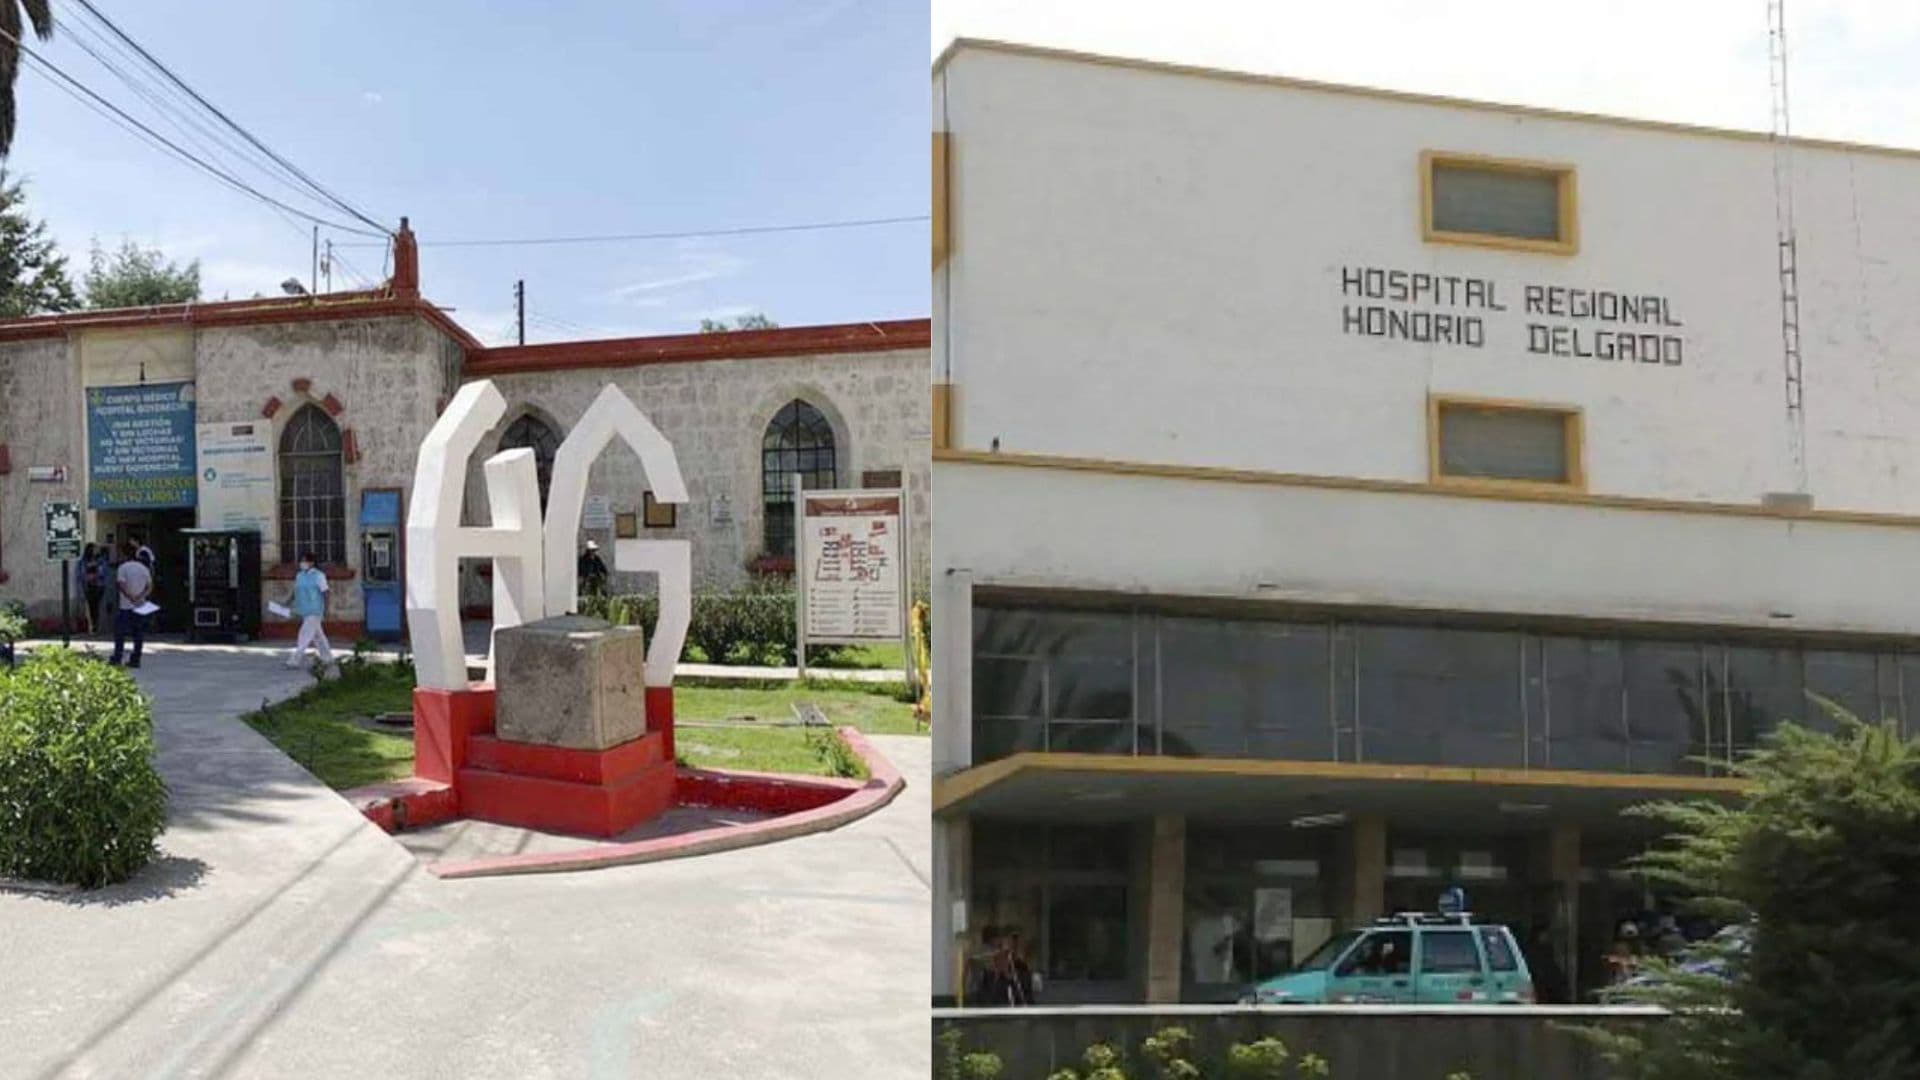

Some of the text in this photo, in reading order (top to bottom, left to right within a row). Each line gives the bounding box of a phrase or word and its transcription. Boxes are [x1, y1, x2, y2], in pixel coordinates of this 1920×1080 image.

[1342, 266, 1684, 327] HOSPITAL REGIONAL
[1342, 305, 1684, 366] HONORIO DELGADO
[96, 405, 136, 415] HOSPITAL
